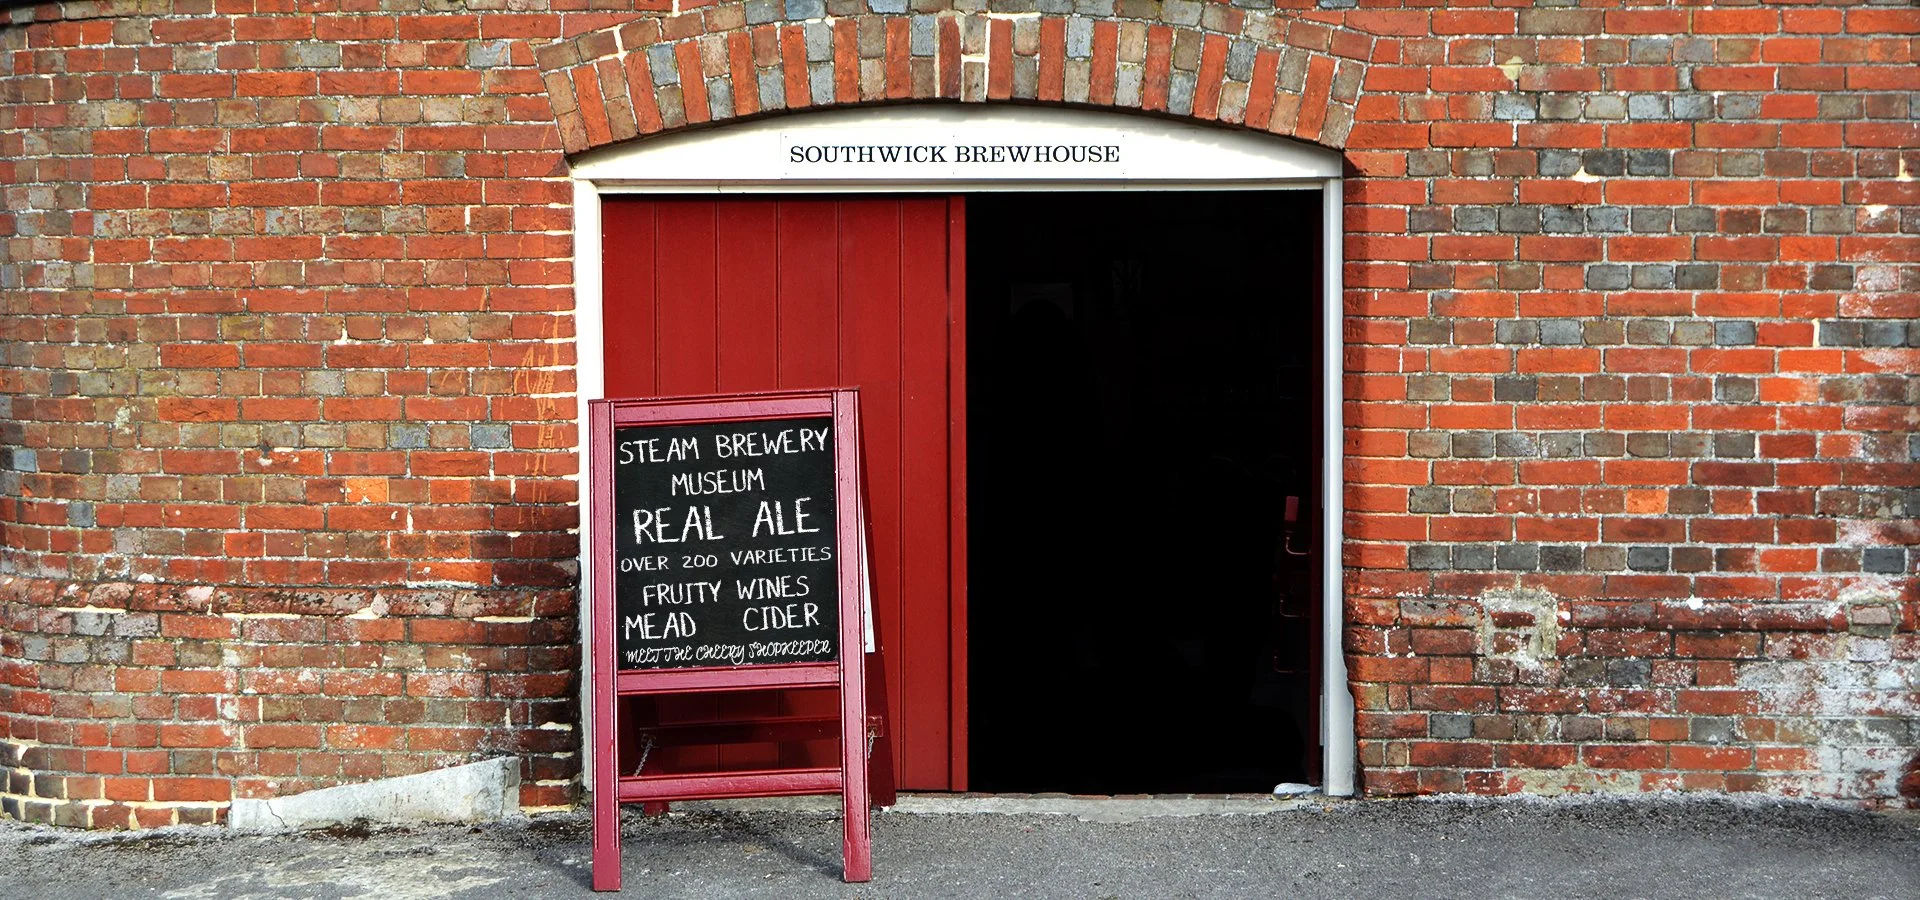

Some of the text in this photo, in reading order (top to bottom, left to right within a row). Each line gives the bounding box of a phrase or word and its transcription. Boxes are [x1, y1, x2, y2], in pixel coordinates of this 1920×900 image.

[790, 145, 1120, 163] SOUTHWICK BREWHOUSE
[620, 427, 828, 464] STEAM BREWERY
[672, 468, 765, 496] MUSEUM
[633, 497, 820, 544] REAL ALE
[620, 547, 831, 572] OVER 200 VARIETIES
[643, 575, 809, 606] FRUITY WINES
[625, 603, 820, 640] MEAD CIDER
[625, 640, 831, 665] MEET THE CHEERY SHOPKEEPER
